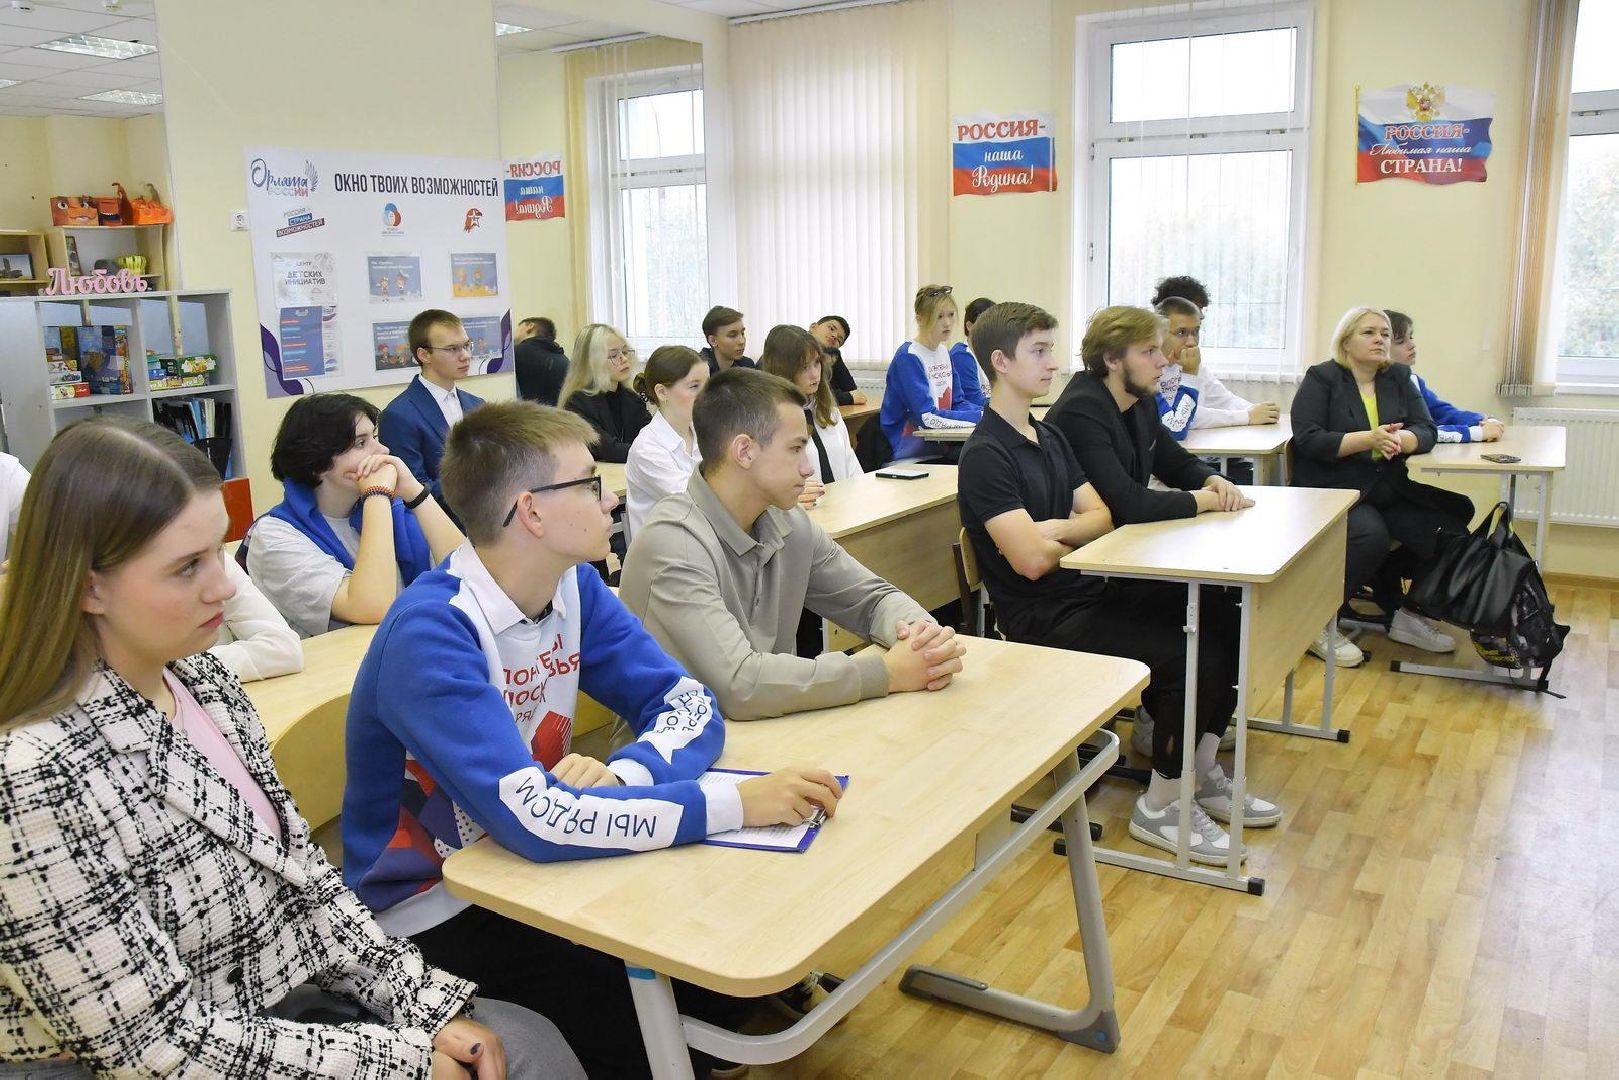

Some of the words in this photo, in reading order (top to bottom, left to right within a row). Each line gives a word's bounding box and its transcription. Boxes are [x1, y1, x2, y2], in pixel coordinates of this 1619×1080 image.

[957, 119, 1046, 141] РОССИЯ-
[984, 149, 1025, 162] наша
[1369, 142, 1433, 156] Любимая
[1435, 146, 1473, 154] наша
[250, 158, 309, 191] Орлята
[1380, 158, 1463, 174] СТРАНА!
[334, 173, 368, 192] ОКНО
[370, 175, 409, 194] ТВОИХ
[411, 177, 499, 197] ВОЗМОЖНОСТЕЙ
[971, 164, 1034, 193] Родина!
[45, 267, 148, 296] Любовь
[515, 776, 598, 835] РЯДОМ
[606, 813, 657, 838] МЫ
